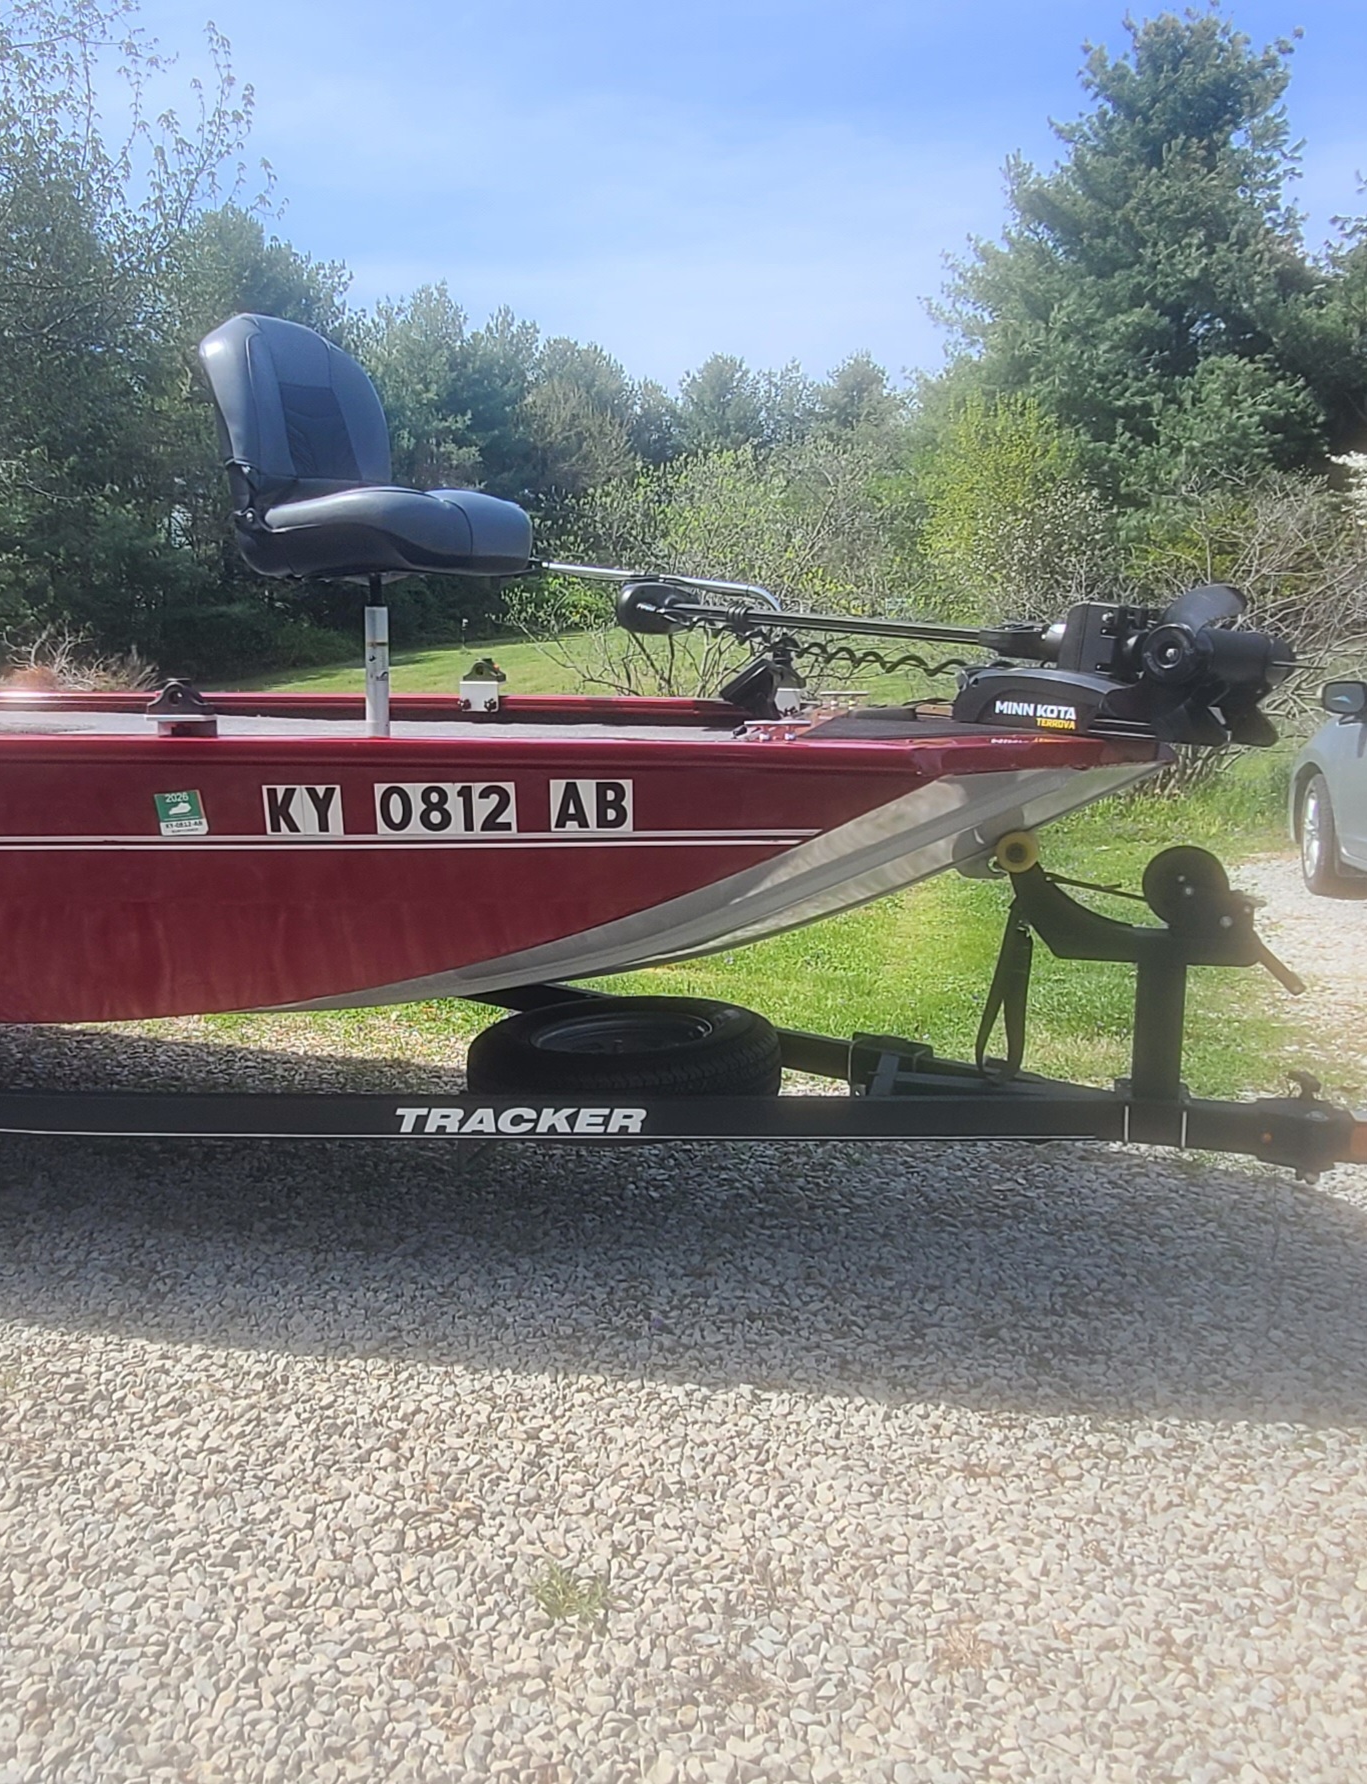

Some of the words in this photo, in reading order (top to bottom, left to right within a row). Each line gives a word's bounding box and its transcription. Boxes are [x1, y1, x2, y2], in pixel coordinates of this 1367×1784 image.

[995, 701, 1034, 716] MINN
[1036, 704, 1076, 720] KOTA
[1036, 718, 1076, 730] TERROVA
[165, 792, 189, 802] 2026
[266, 787, 336, 833] KY
[380, 785, 511, 831] 0812
[555, 782, 628, 829] AB
[396, 1108, 647, 1133] TRACKER
